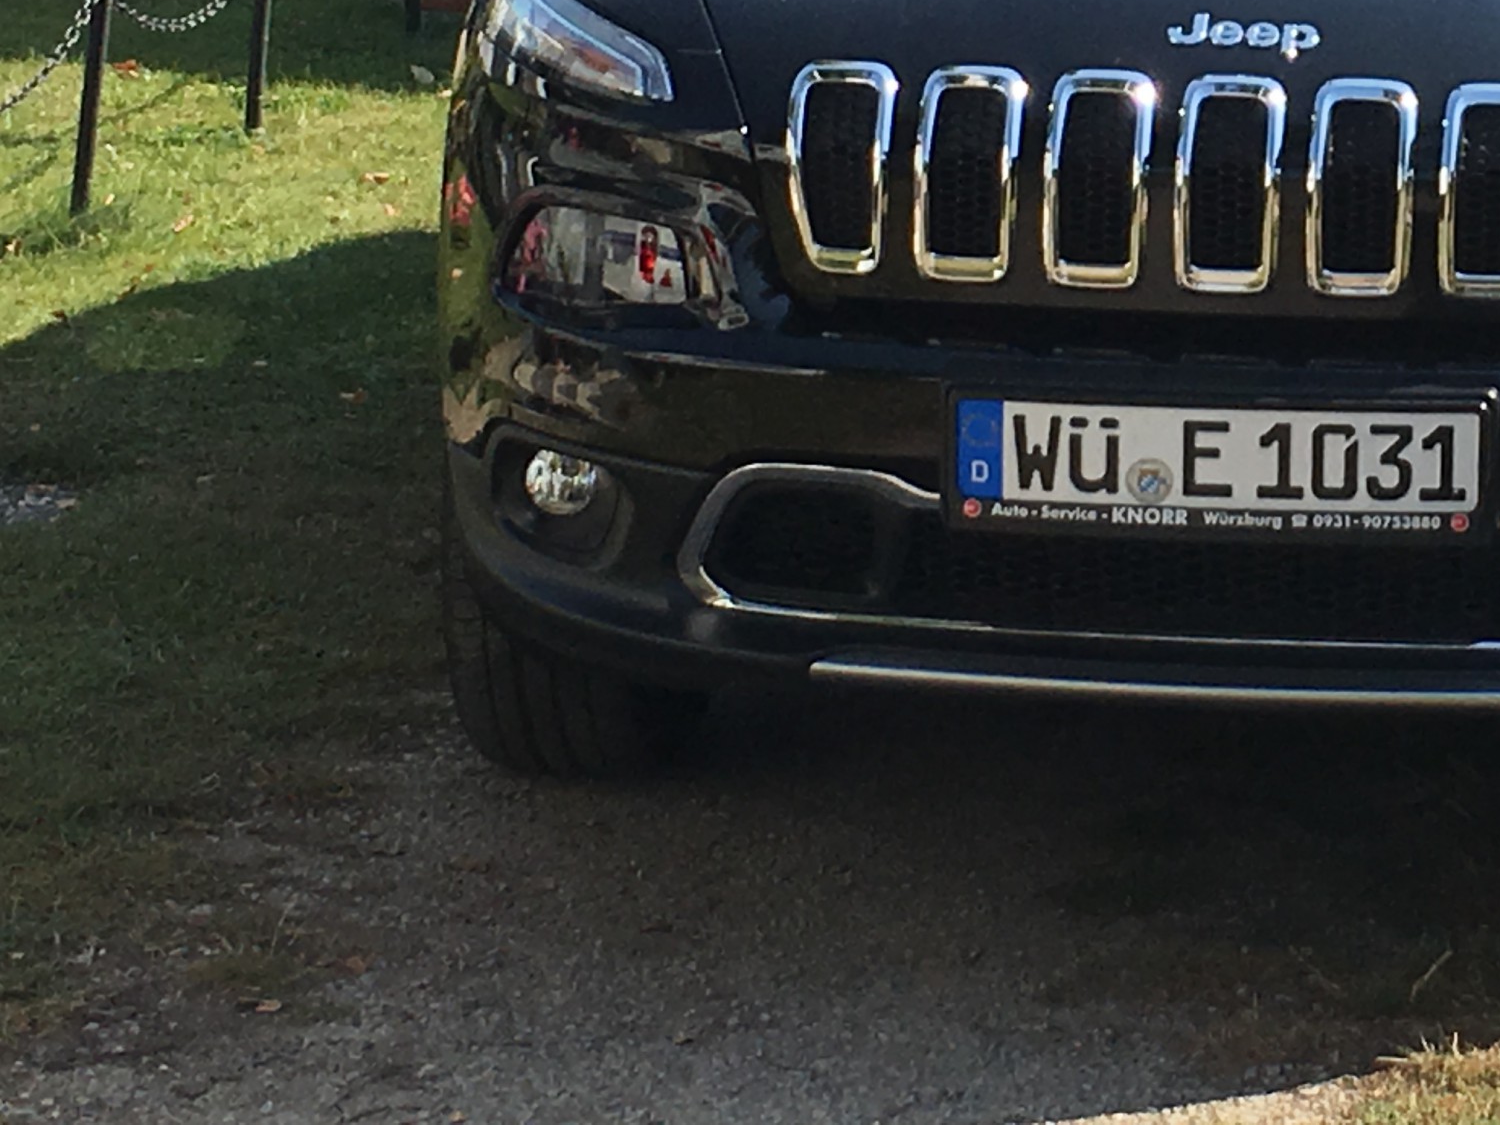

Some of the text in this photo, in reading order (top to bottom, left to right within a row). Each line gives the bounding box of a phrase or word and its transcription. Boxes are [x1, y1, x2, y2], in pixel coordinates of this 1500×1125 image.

[1167, 12, 1321, 63] Jeep
[970, 460, 989, 483] D
[1012, 414, 1466, 502] WÜ E 1031
[1111, 506, 1188, 525] KNORR
[1203, 510, 1283, 530] Würzburg
